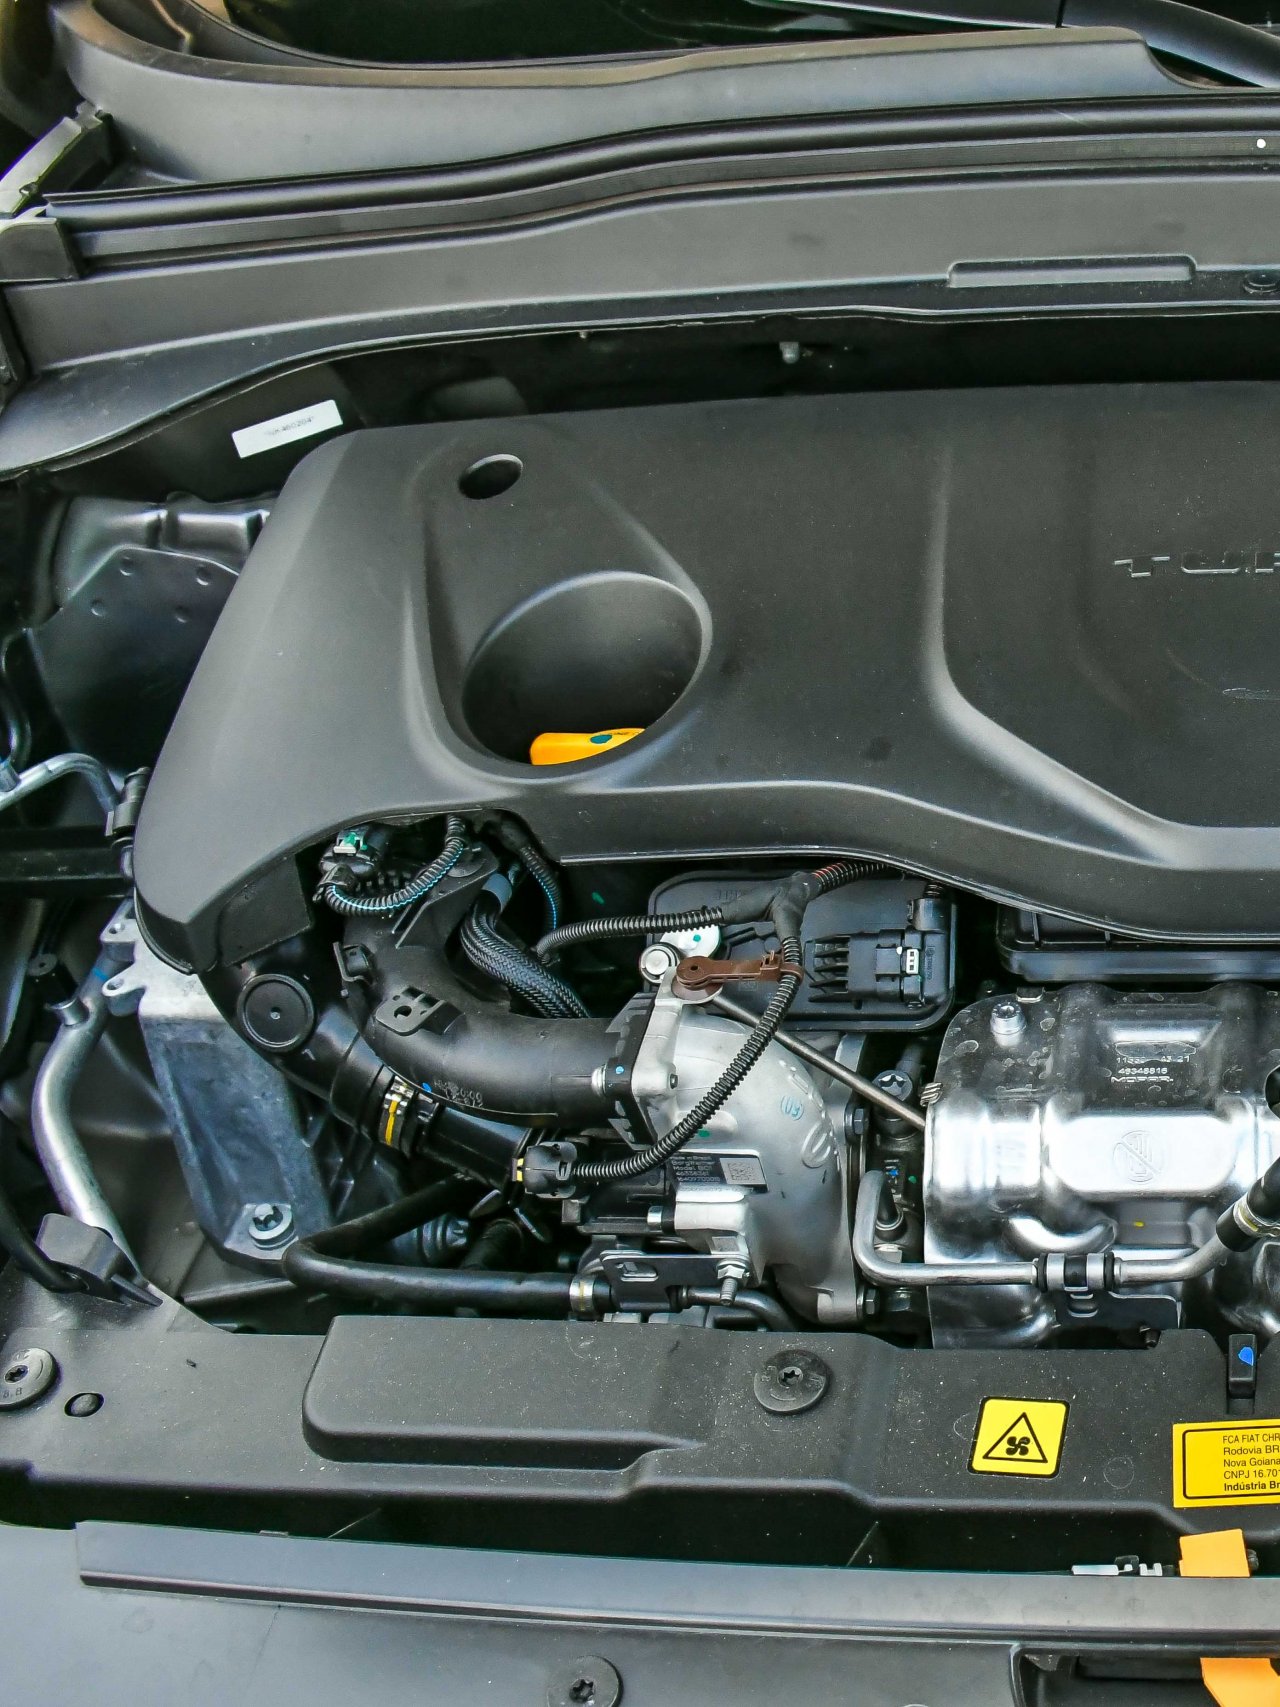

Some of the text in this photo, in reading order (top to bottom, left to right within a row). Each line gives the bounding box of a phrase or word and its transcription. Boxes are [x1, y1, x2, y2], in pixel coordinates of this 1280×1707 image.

[1222, 1436, 1240, 1444] FCA
[1242, 1434, 1260, 1442] FIAT
[1224, 1447, 1262, 1456] Rodovia
[1224, 1459, 1246, 1468] Nova
[1224, 1470, 1250, 1480] CNPJ
[1224, 1481, 1266, 1491] Indústria
